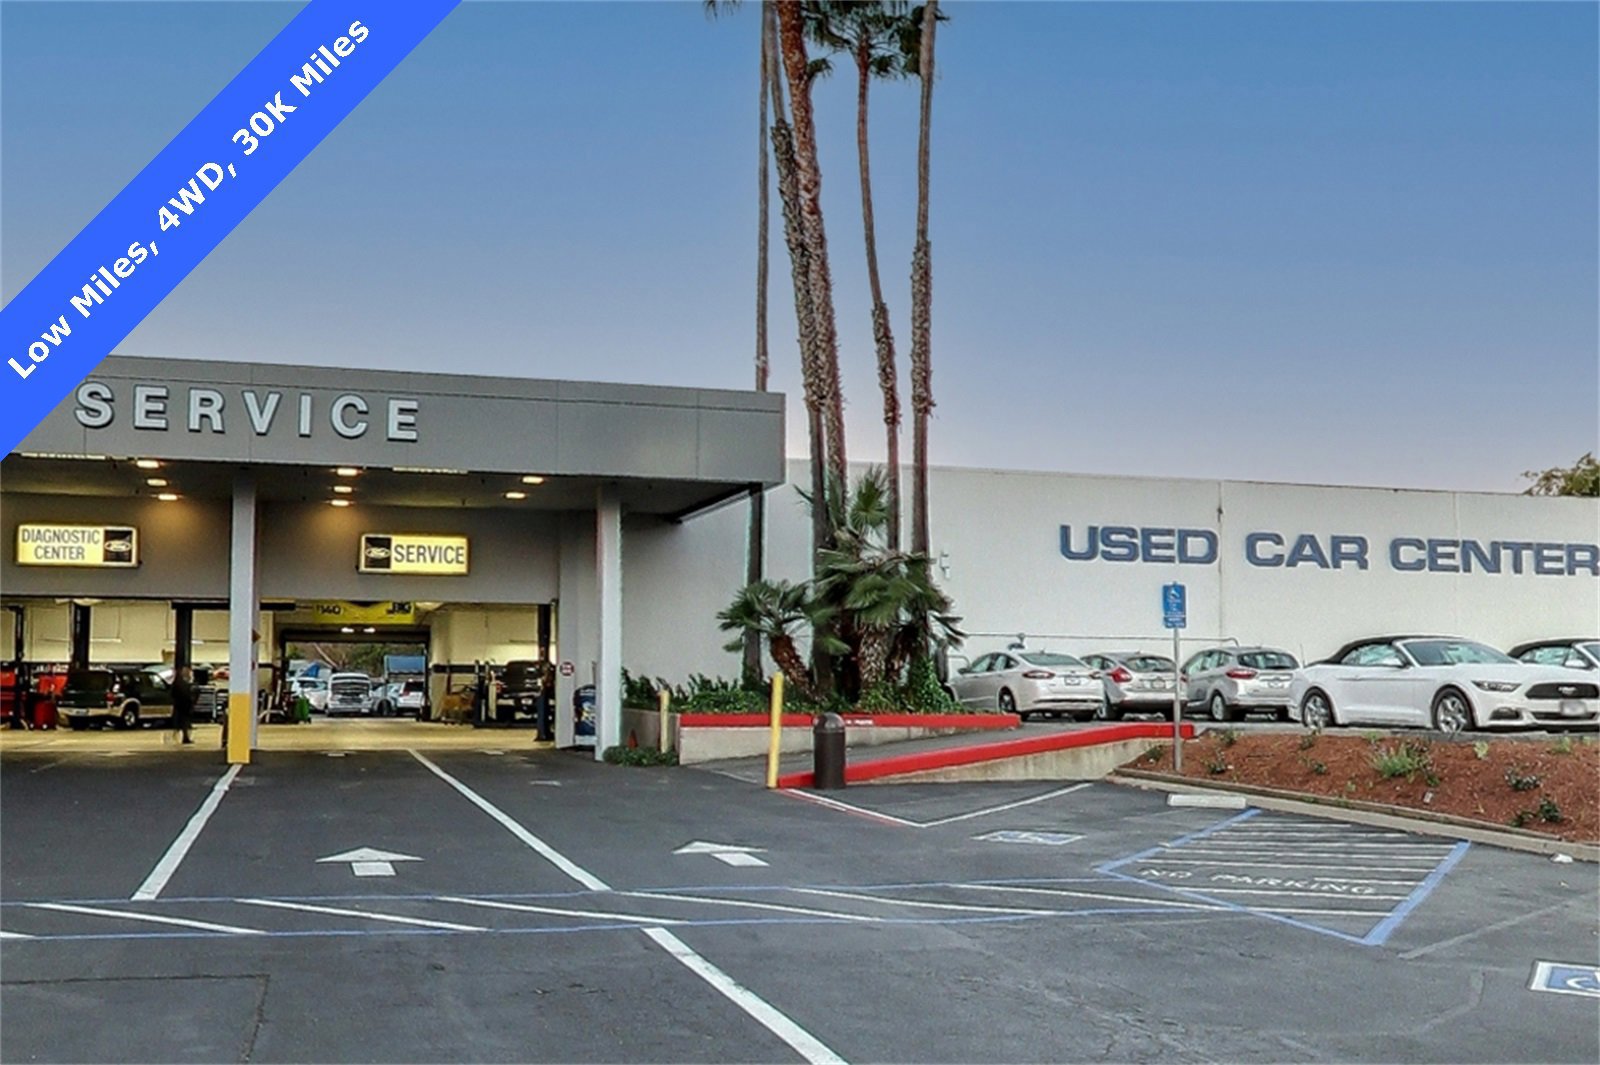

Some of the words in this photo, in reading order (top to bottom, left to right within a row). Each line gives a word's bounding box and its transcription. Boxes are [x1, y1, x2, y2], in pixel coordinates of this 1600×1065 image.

[74, 381, 419, 441] SERVICE
[21, 528, 100, 545] DIAGNOSTIC
[34, 545, 85, 560] CENTER
[393, 544, 465, 565] SERVICE
[1059, 525, 1219, 565] USED
[1245, 532, 1369, 570] CAR
[1389, 537, 1600, 576] CENTER
[1138, 867, 1193, 879] NO
[1209, 873, 1376, 895] PARKING
